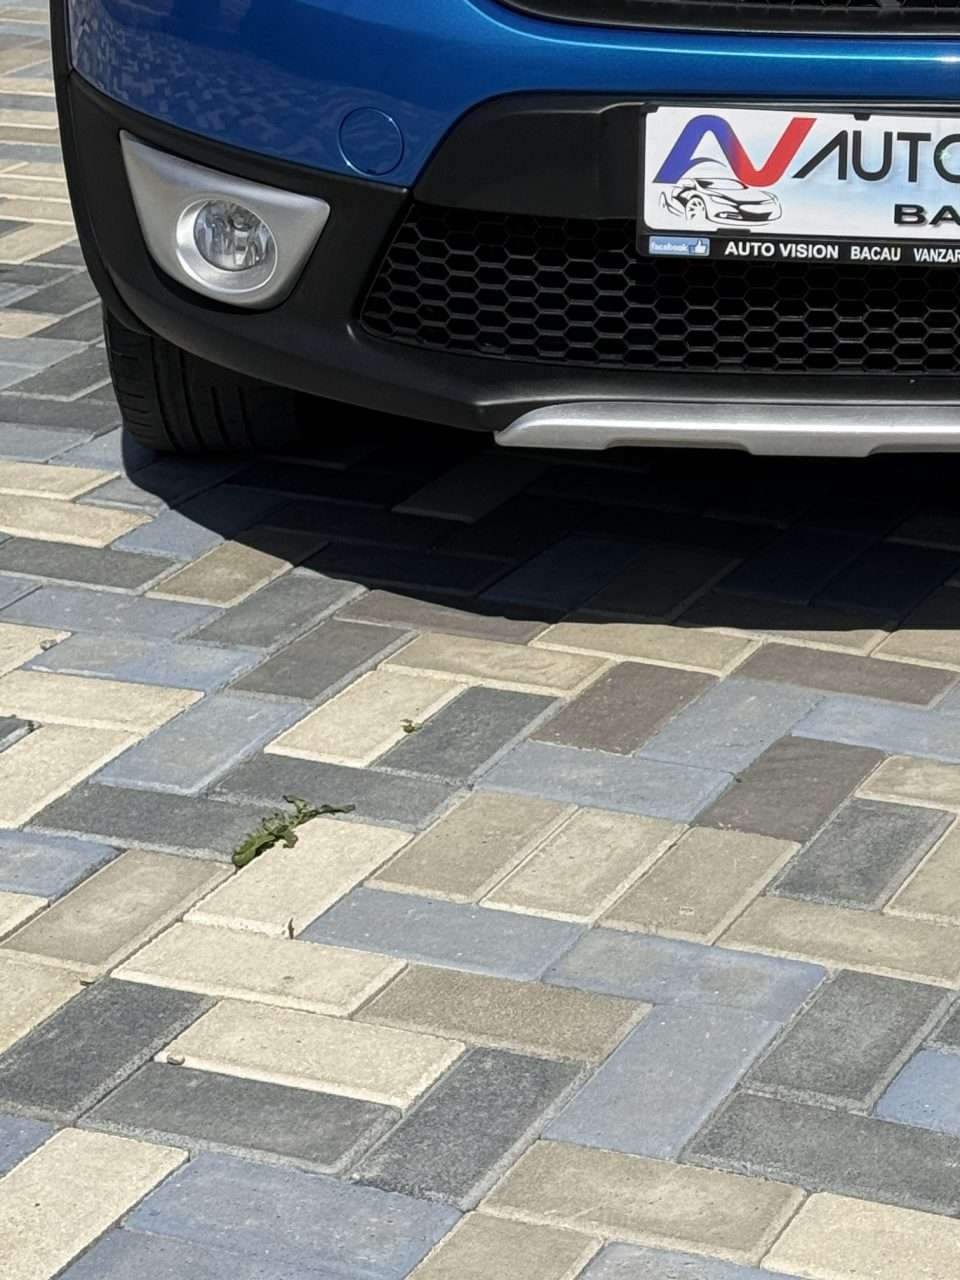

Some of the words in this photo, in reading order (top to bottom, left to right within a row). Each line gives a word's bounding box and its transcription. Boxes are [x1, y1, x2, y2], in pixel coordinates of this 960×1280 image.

[724, 241, 776, 257] AUTO
[778, 243, 839, 259] VISION
[850, 245, 901, 261] BACAU
